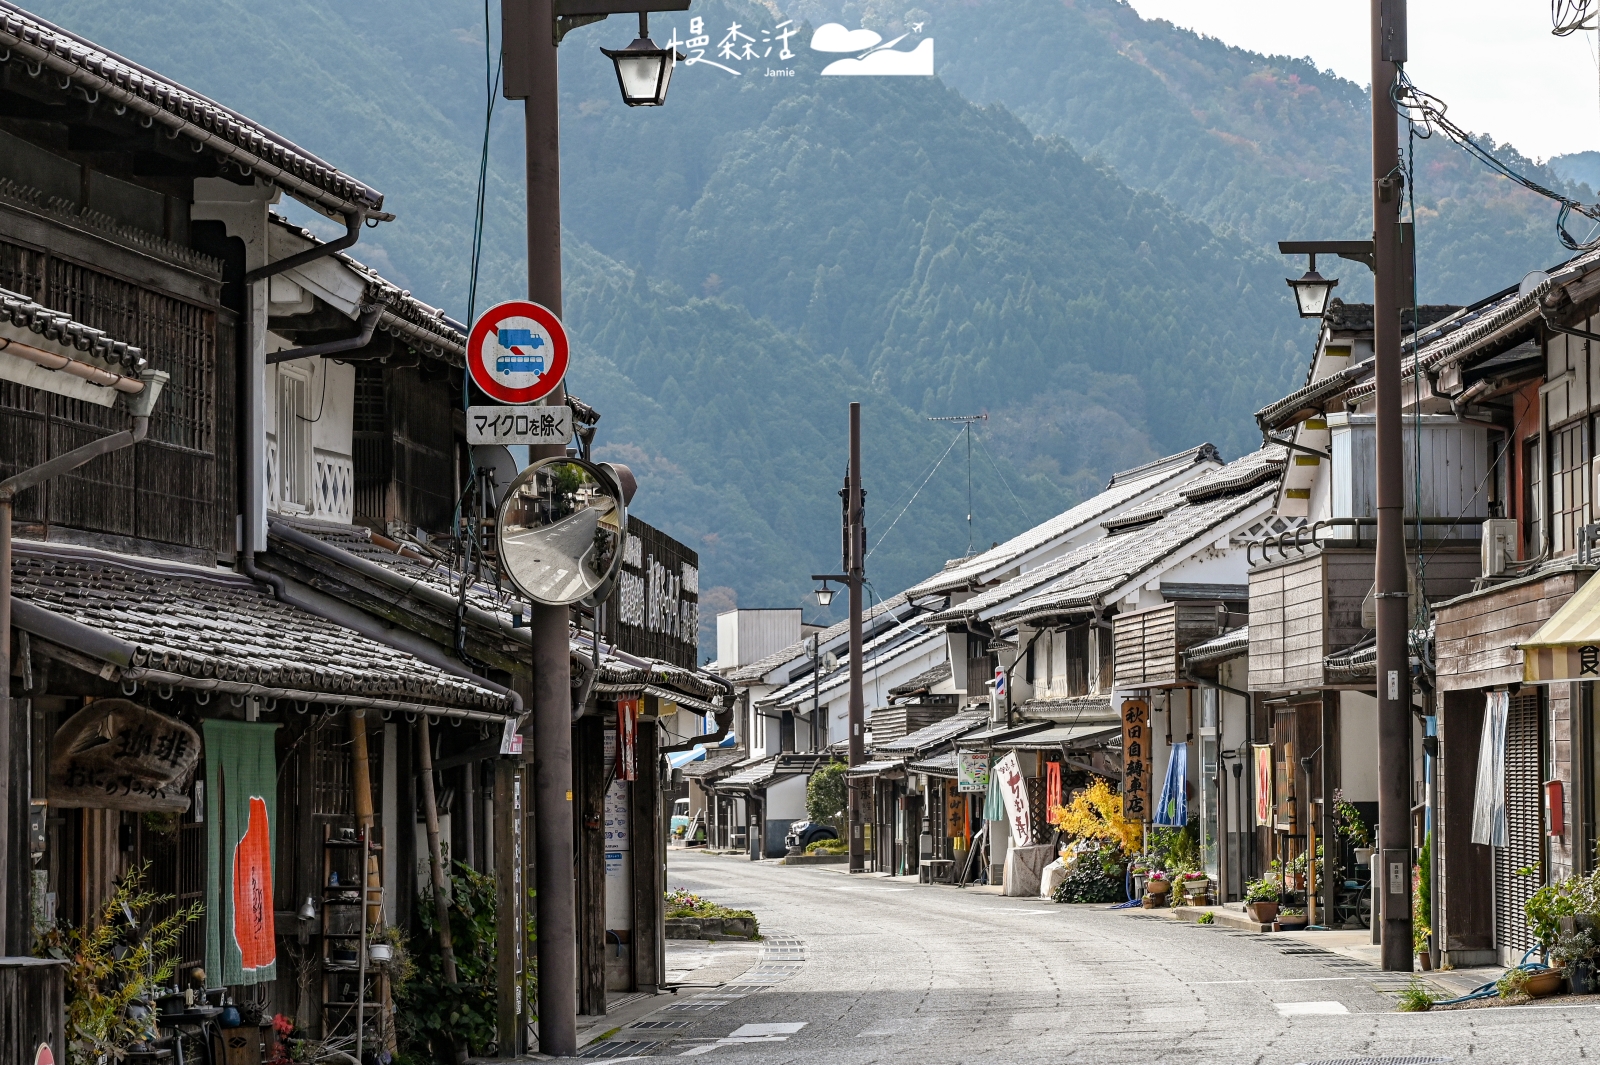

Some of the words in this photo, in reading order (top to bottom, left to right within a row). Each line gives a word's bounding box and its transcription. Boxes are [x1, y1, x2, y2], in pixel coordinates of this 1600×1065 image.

[473, 414, 564, 437] マイクロを除く
[1578, 645, 1600, 676] 食
[113, 724, 188, 768] 珈琲
[1126, 706, 1146, 814] 秋田自轉車店
